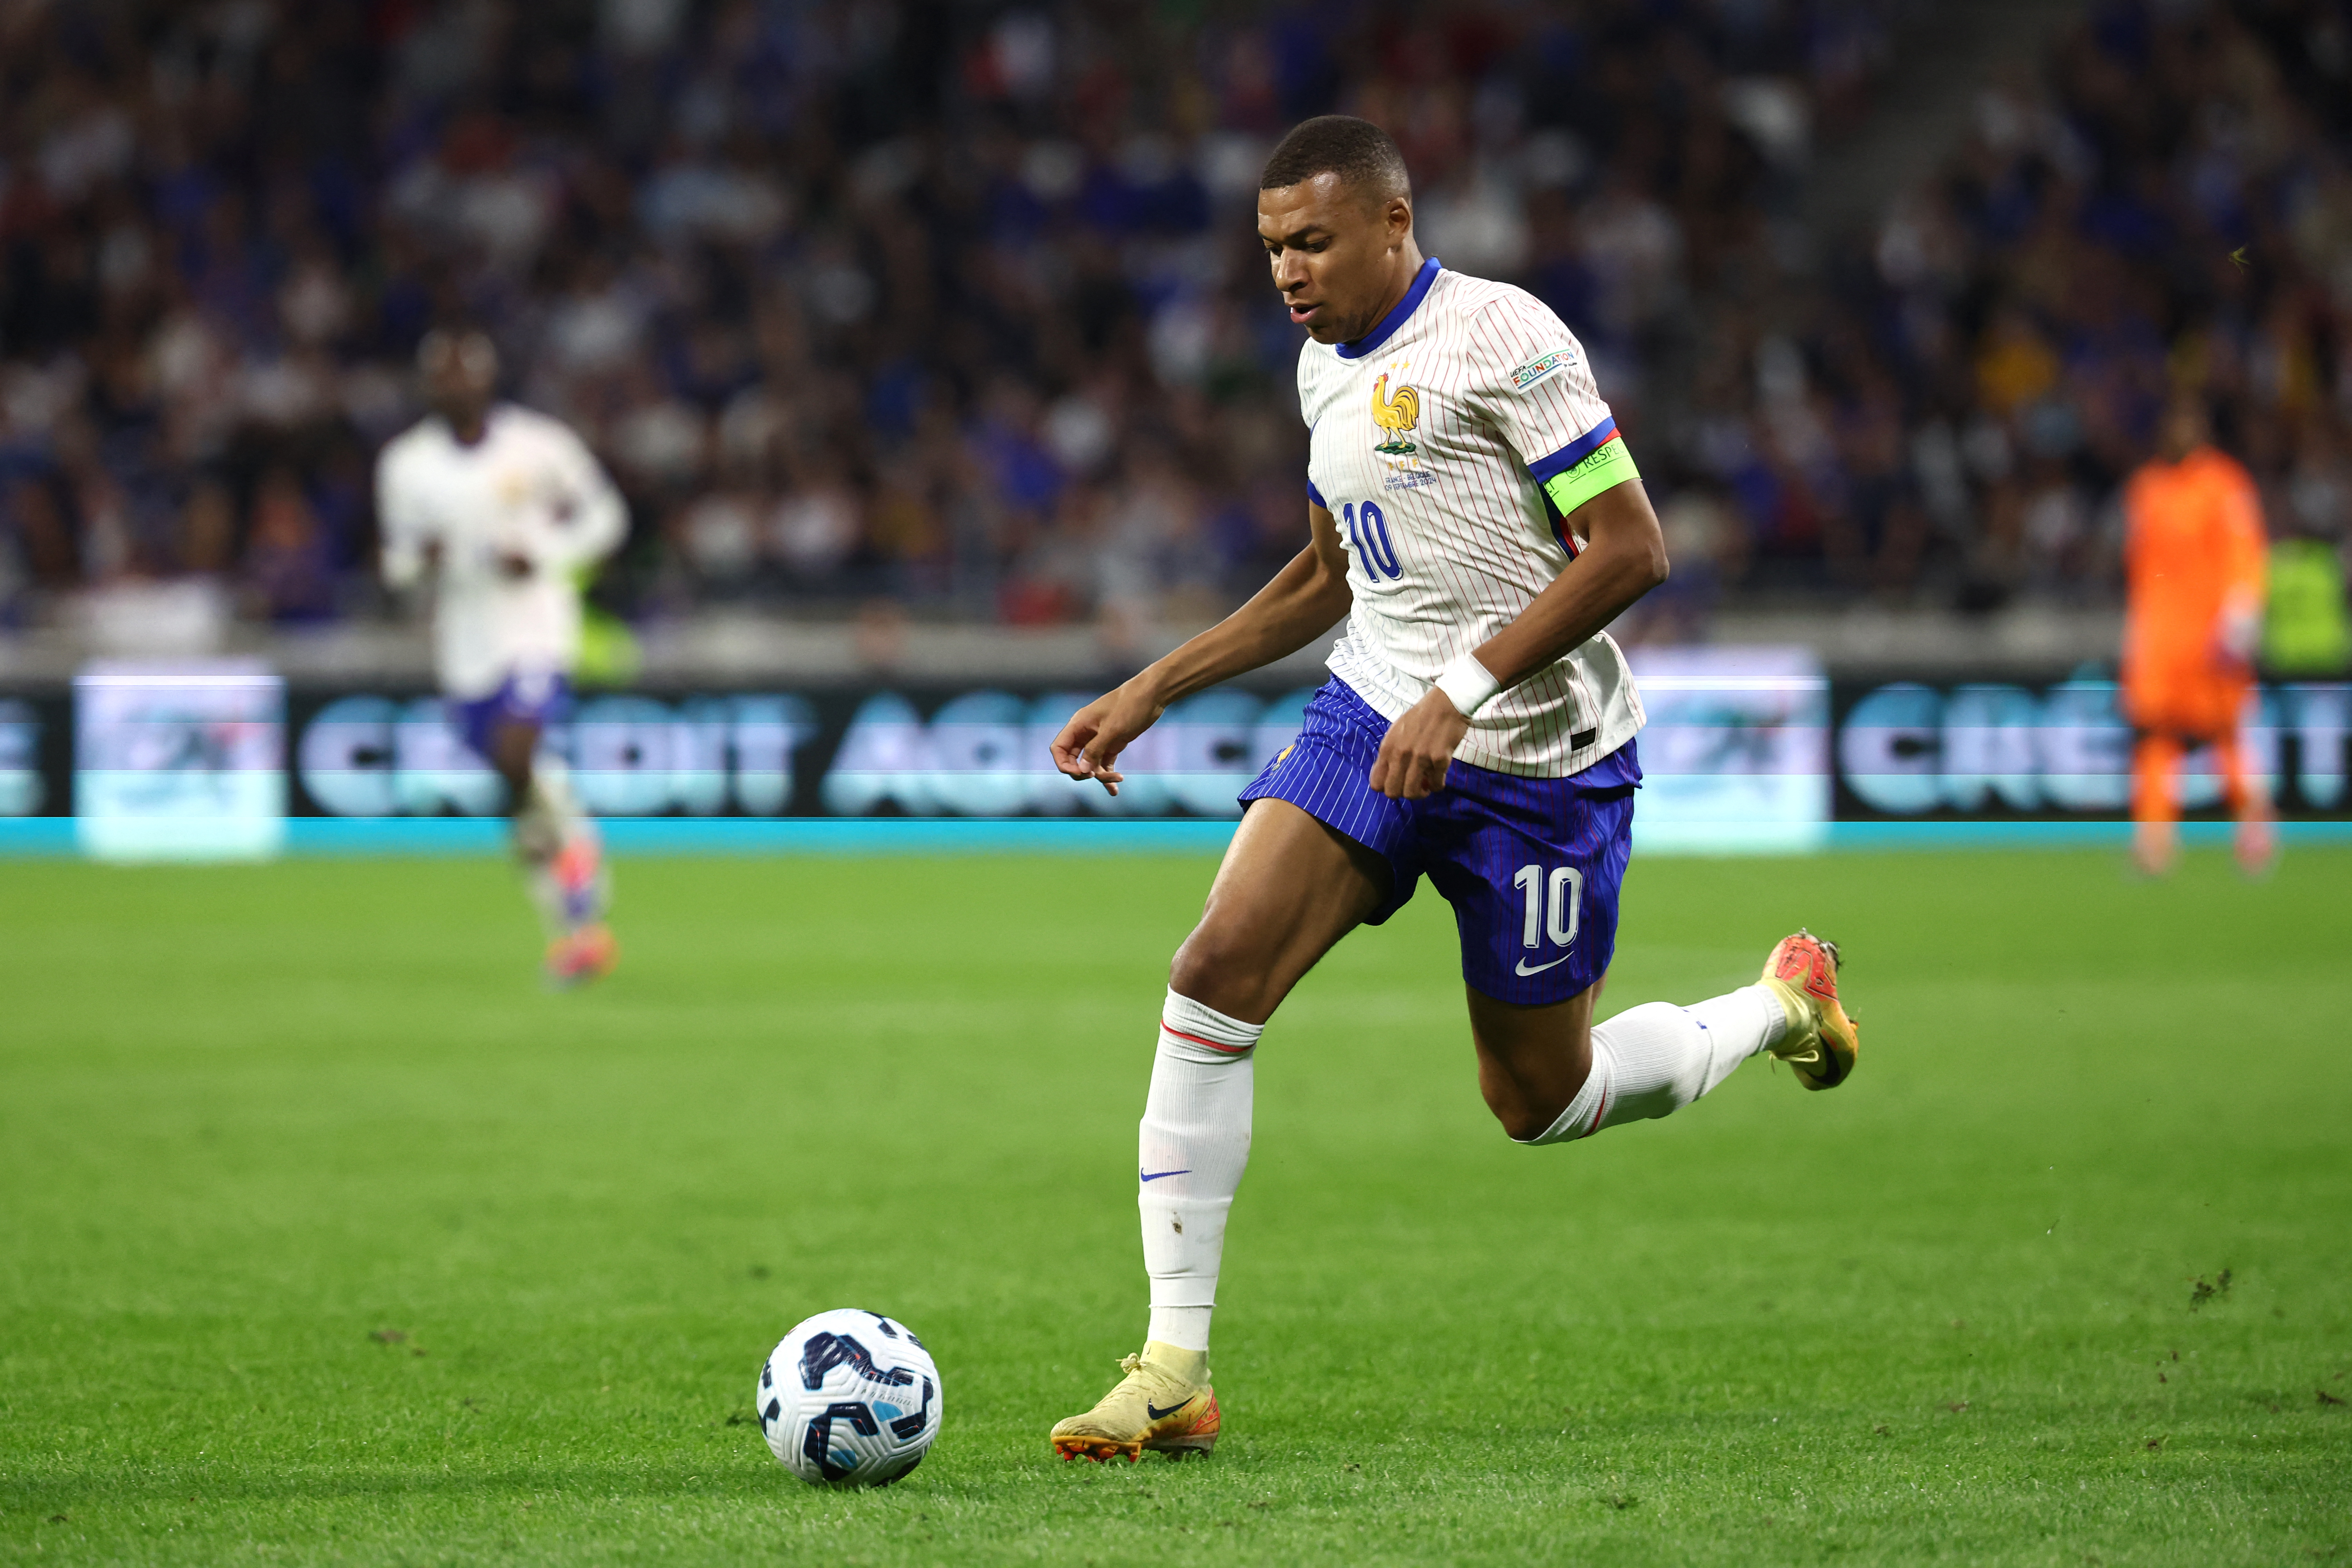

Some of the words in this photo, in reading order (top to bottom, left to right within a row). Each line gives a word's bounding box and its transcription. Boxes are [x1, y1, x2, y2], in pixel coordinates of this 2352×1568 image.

[1510, 365, 1526, 377] UEFA
[1513, 352, 1574, 386] FOUNDATION
[1385, 475, 1403, 484] FRANCE
[1407, 471, 1431, 481] BELGIQUE
[1420, 477, 1437, 486] 2024
[1343, 501, 1404, 583] 10
[297, 693, 818, 817] CRDIT
[1514, 864, 1583, 948] 10
